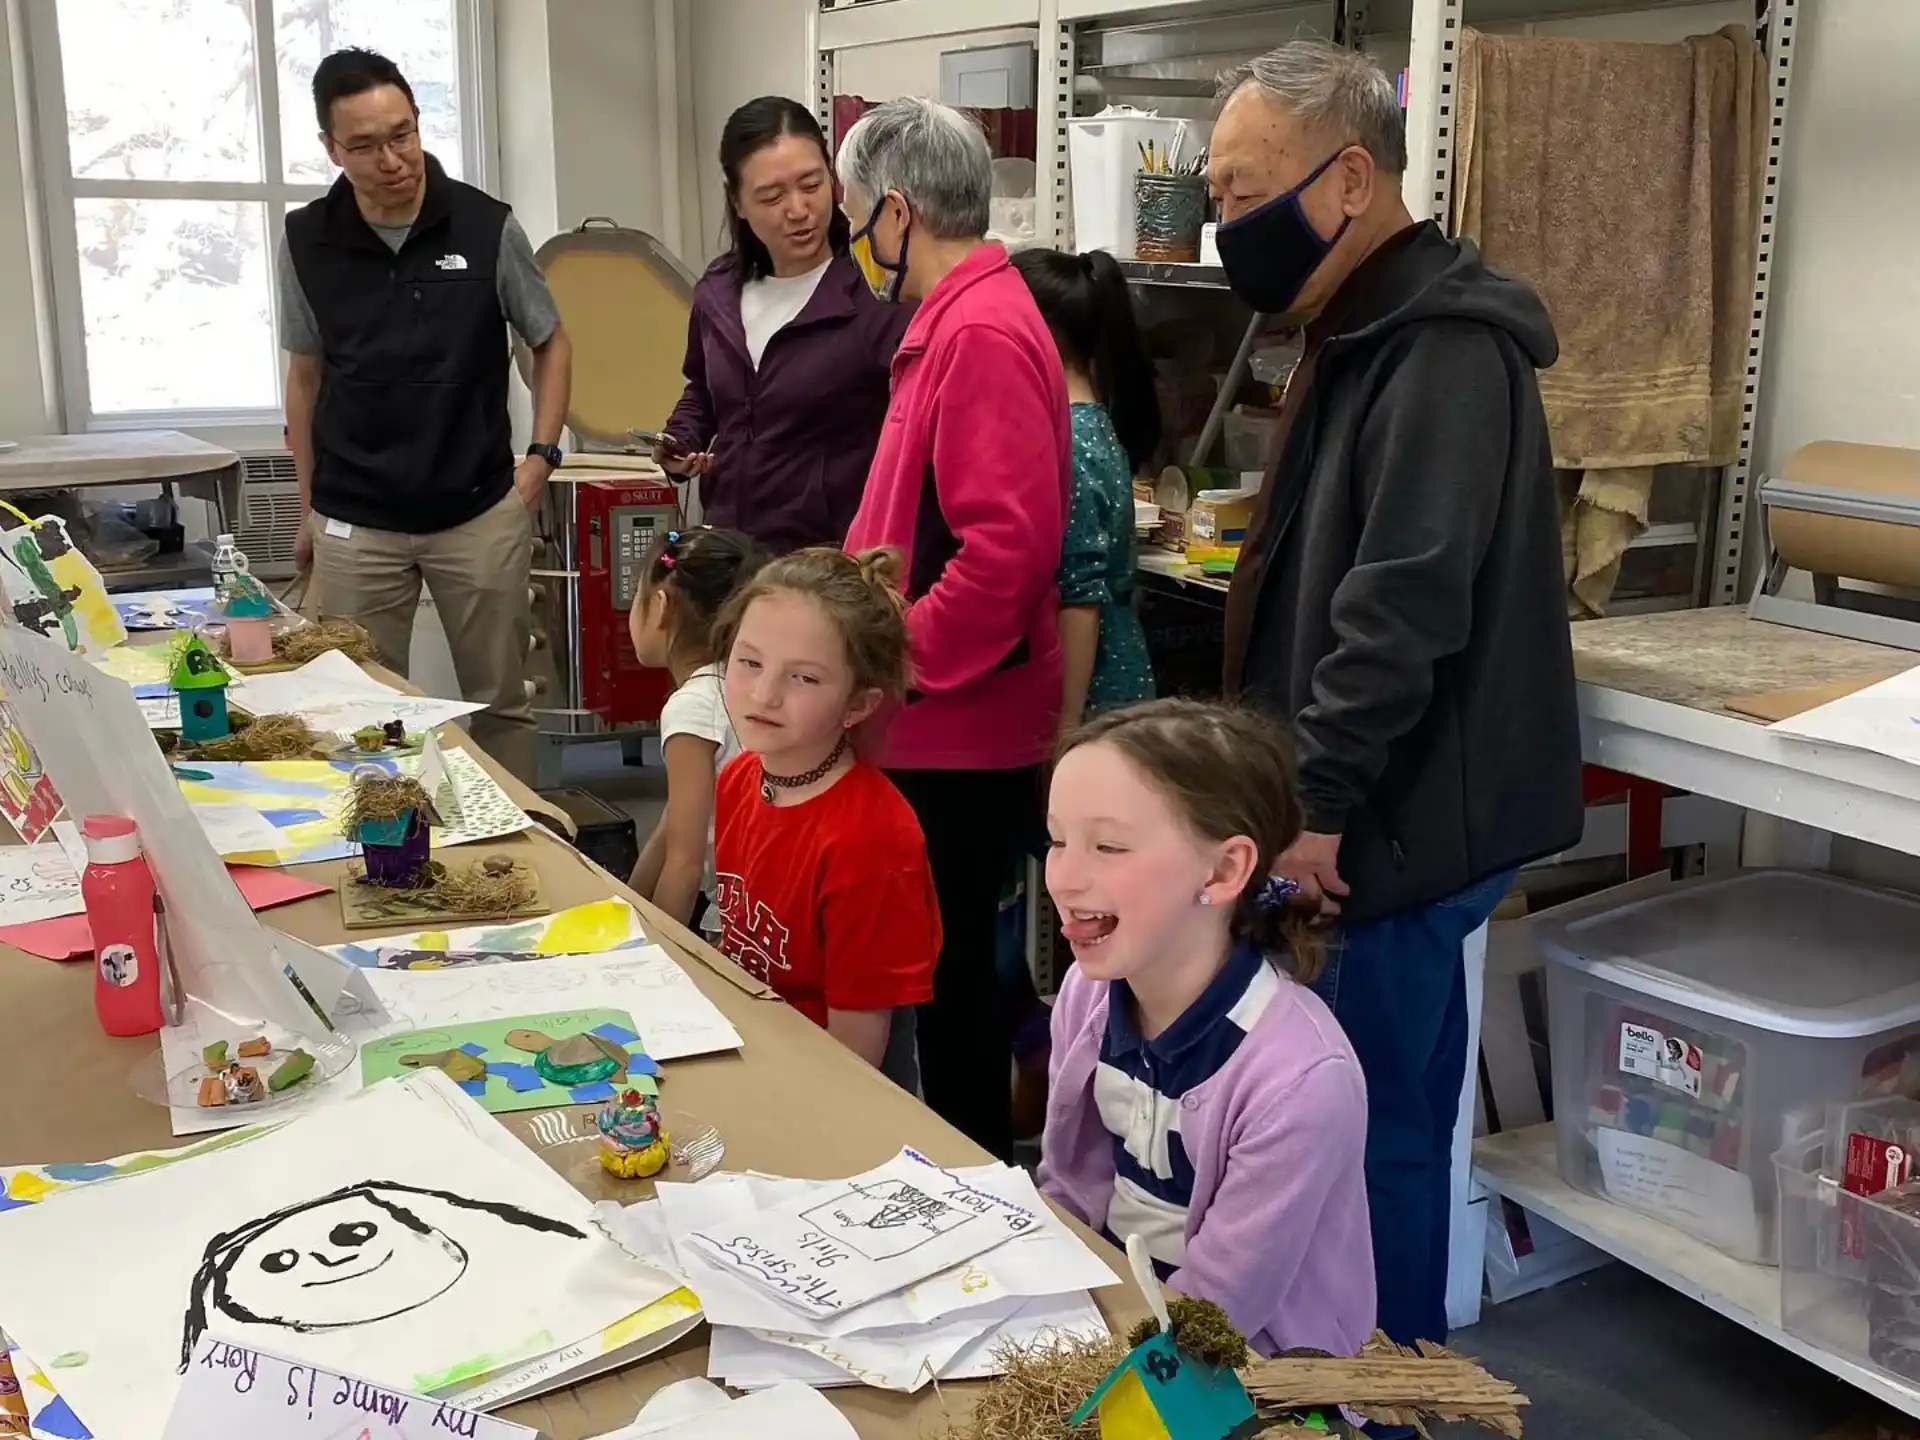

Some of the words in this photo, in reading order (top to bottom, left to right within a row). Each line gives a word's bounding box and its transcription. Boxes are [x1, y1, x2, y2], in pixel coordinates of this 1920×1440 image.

[1625, 1026, 1655, 1042] bella
[941, 1189, 994, 1214] Rory
[1002, 1211, 1032, 1231] By
[199, 1341, 259, 1394] Rory
[285, 1367, 317, 1421] is
[334, 1376, 409, 1427] Name
